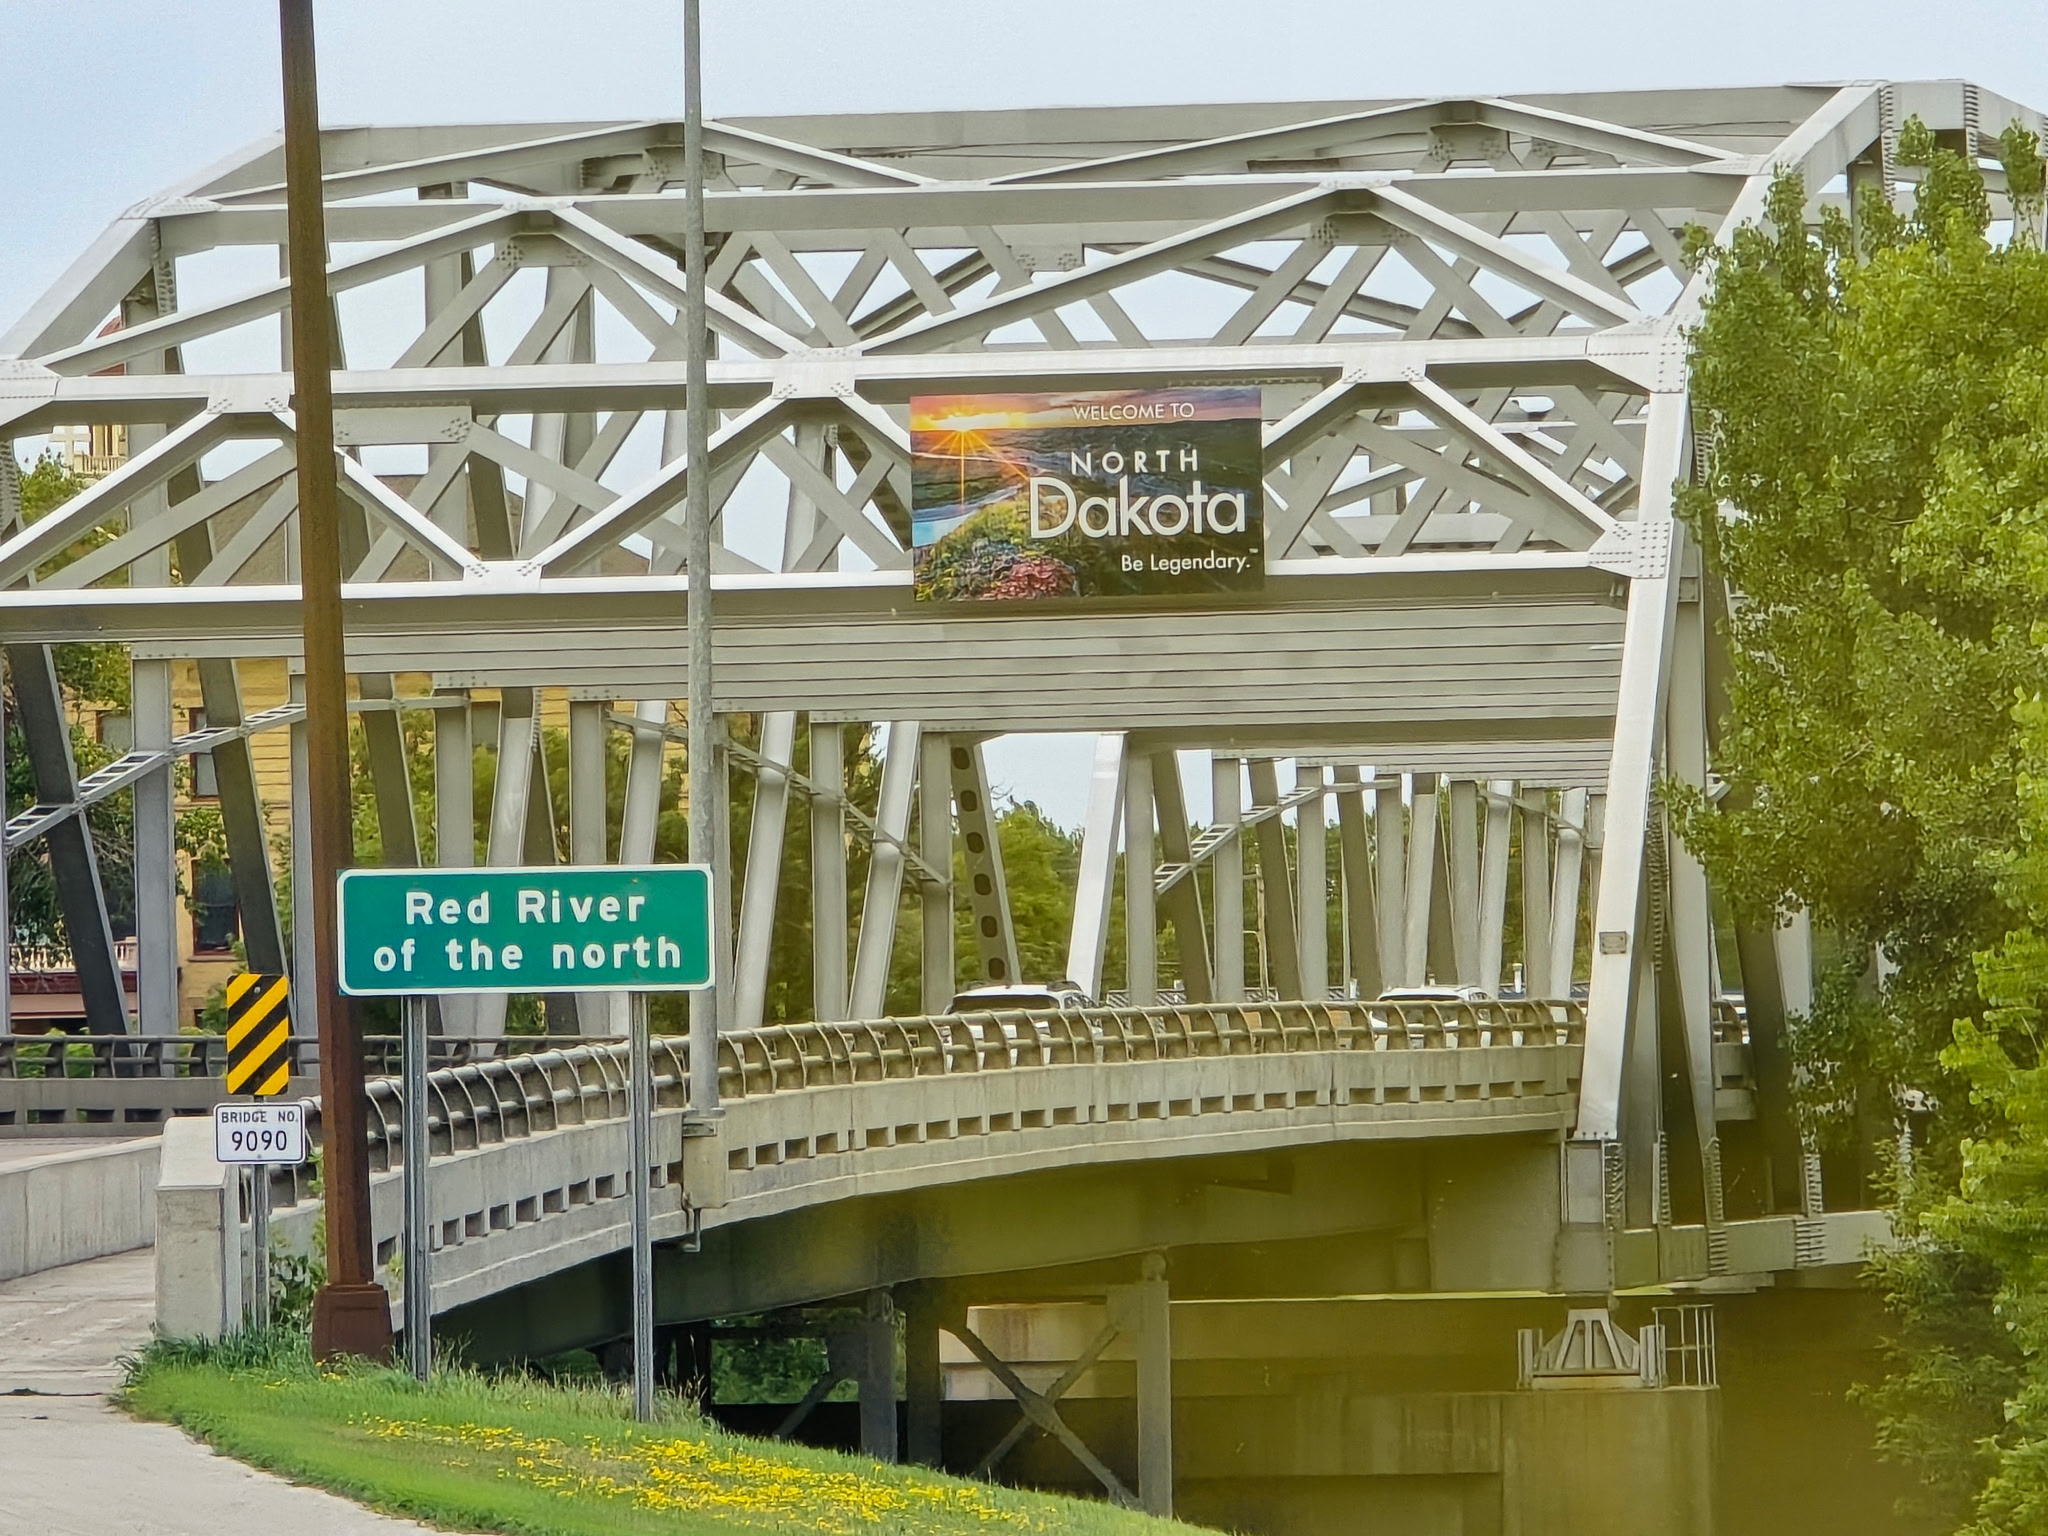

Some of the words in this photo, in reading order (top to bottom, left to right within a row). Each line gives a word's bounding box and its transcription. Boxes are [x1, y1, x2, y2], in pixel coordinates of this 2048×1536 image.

[1072, 403, 1165, 421] WELCOME
[1169, 402, 1195, 419] TO
[1071, 449, 1199, 476] NORTH
[1029, 475, 1247, 539] Dakota
[1121, 554, 1144, 572] Be
[405, 891, 490, 925] Red
[517, 889, 646, 924] River
[373, 938, 416, 972] of
[445, 938, 524, 971] the
[552, 935, 682, 969] north
[221, 1111, 267, 1123] BRIDGE
[278, 1110, 298, 1123] NO.
[231, 1130, 287, 1151] 9090
